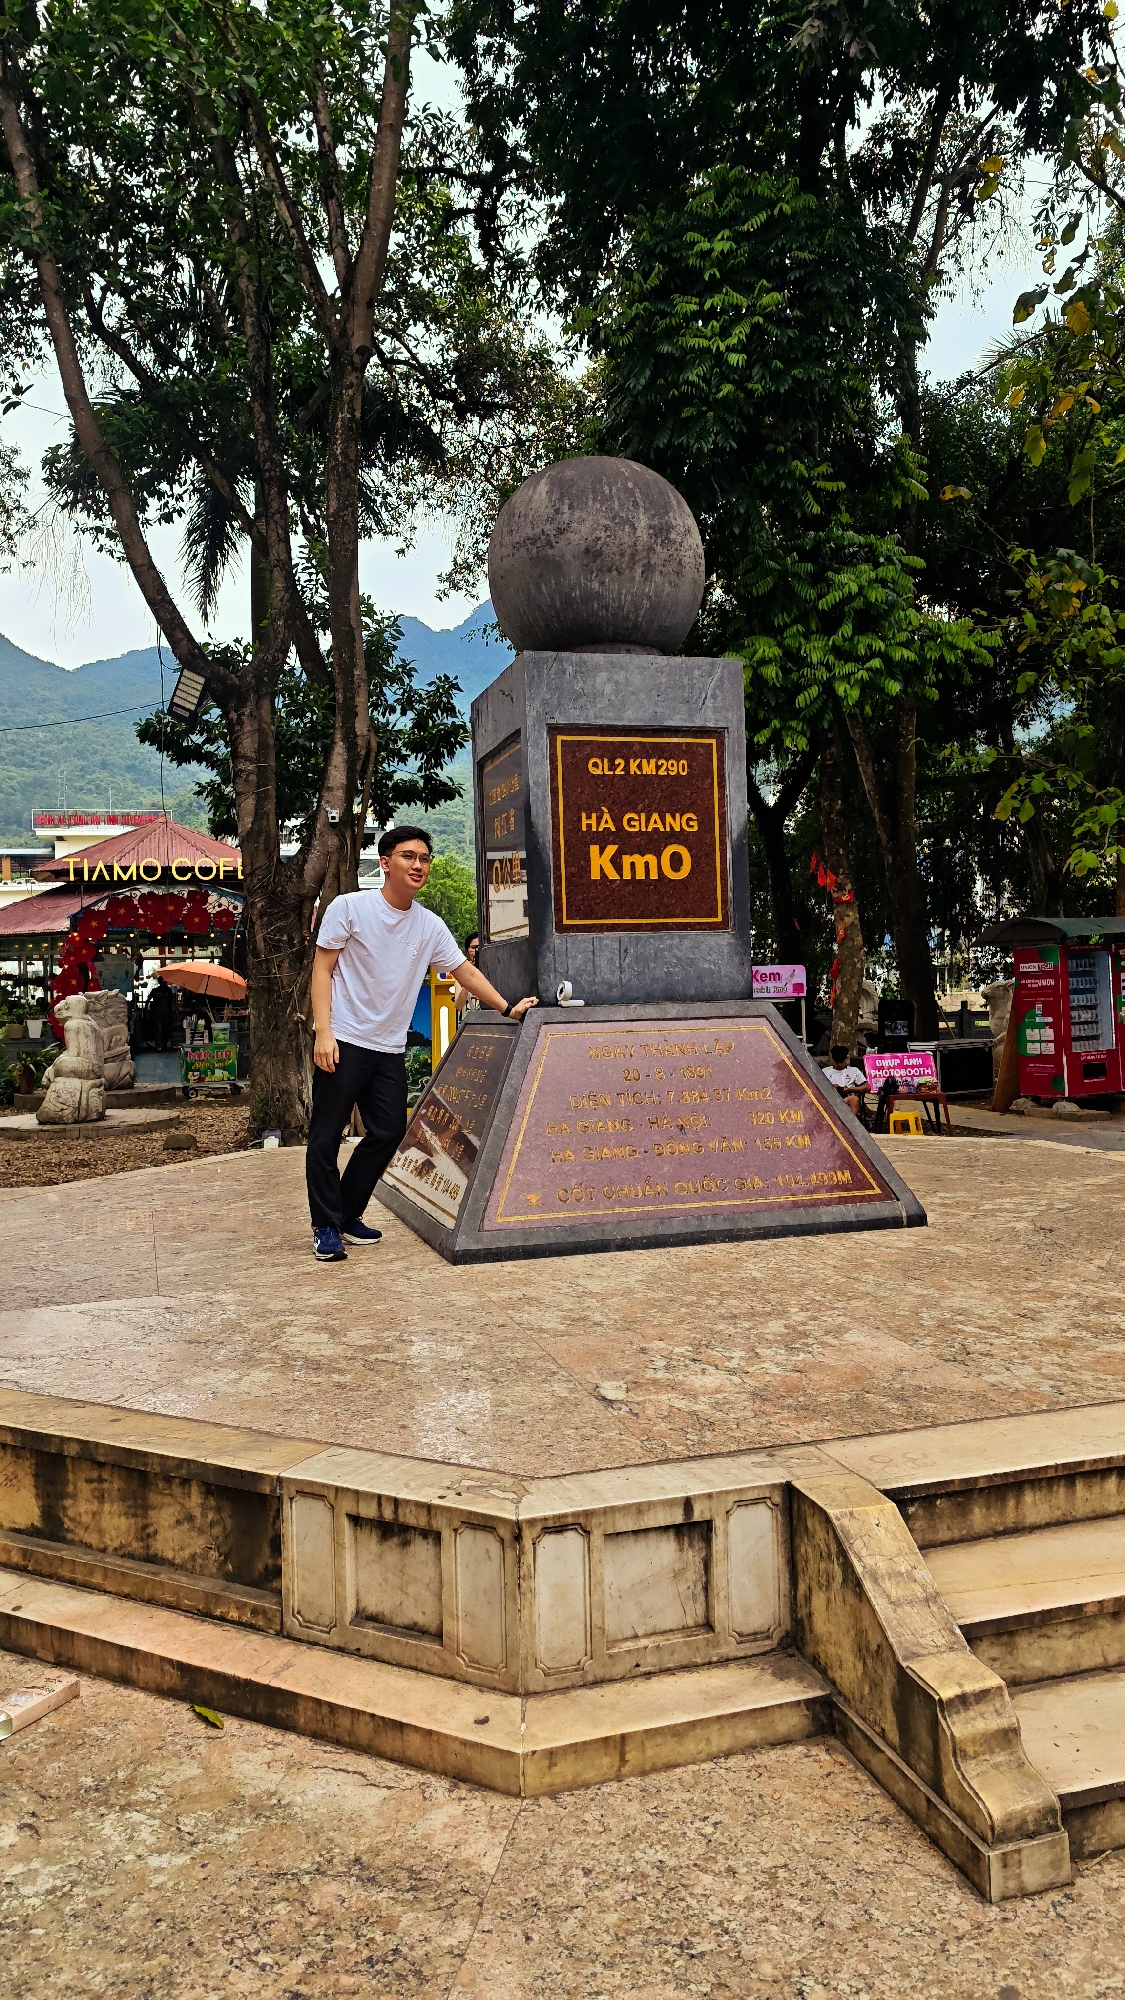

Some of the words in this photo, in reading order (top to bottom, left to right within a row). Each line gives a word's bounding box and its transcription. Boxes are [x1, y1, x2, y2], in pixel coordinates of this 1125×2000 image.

[588, 757, 625, 775] QL2
[629, 758, 689, 776] KM290
[581, 806, 616, 832] HÀ
[622, 812, 699, 832] GIANG
[61, 857, 162, 881] TIAMO
[752, 969, 781, 983] Kem
[640, 1039, 699, 1057] THÀNH
[703, 1038, 735, 1057] LẬP
[870, 1067, 932, 1077] PHOTOBOOTH
[875, 1058, 900, 1067] CHỤP
[622, 1068, 641, 1082] 20
[655, 1067, 665, 1081] 8
[680, 1065, 713, 1080] 1891
[569, 1091, 612, 1110] DIỆN
[616, 1089, 662, 1106] TÍCH:
[736, 1086, 772, 1101] Km2
[546, 1116, 573, 1135] HÀ
[576, 1118, 634, 1134] GIANG
[647, 1112, 673, 1130] HÀ
[748, 1111, 775, 1125] 320
[778, 1108, 805, 1124] KM
[551, 1144, 577, 1163] HÀ
[581, 1144, 639, 1161] GIANG
[754, 1137, 782, 1151] 155
[785, 1133, 812, 1149] KM
[674, 1172, 729, 1195] QUỐC
